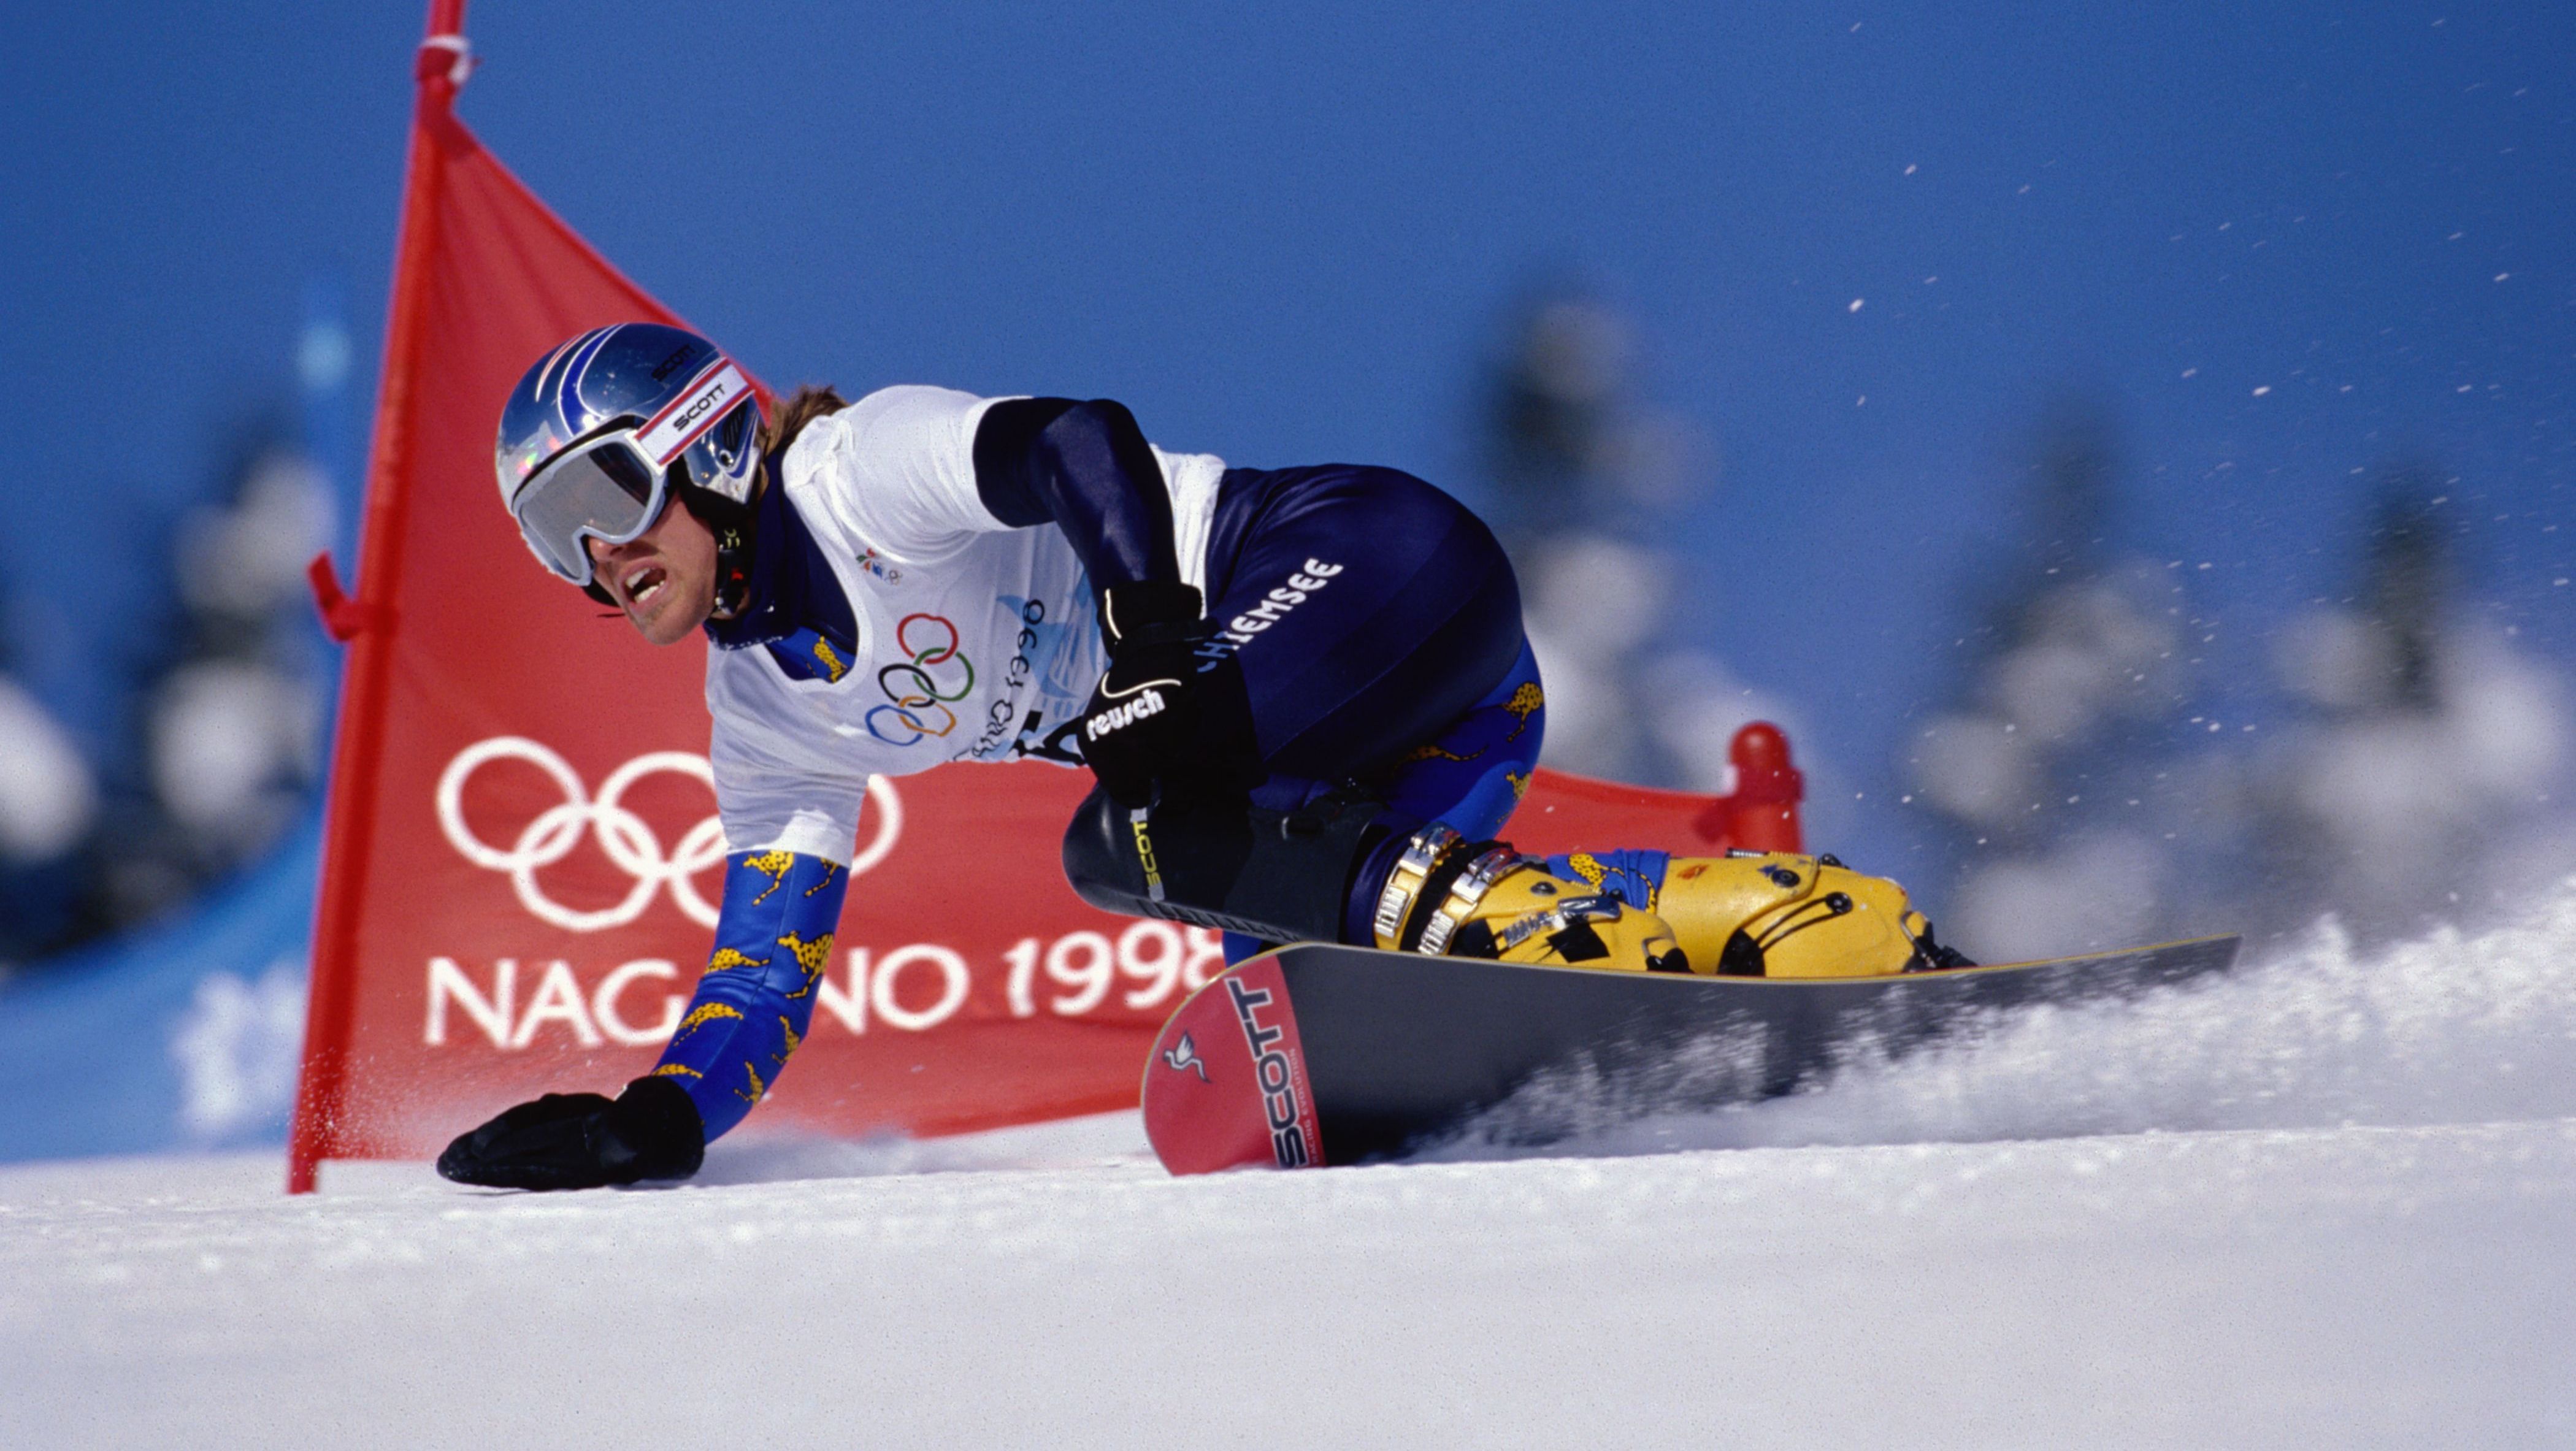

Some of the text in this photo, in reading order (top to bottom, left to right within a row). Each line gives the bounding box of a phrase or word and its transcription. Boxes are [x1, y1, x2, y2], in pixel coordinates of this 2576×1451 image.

[651, 344, 696, 381] SCOTT
[673, 383, 725, 432] SCOTT
[1086, 688, 1165, 741] reusch
[424, 943, 970, 1049] NAGNO
[1224, 978, 1309, 1170] SCOTT
